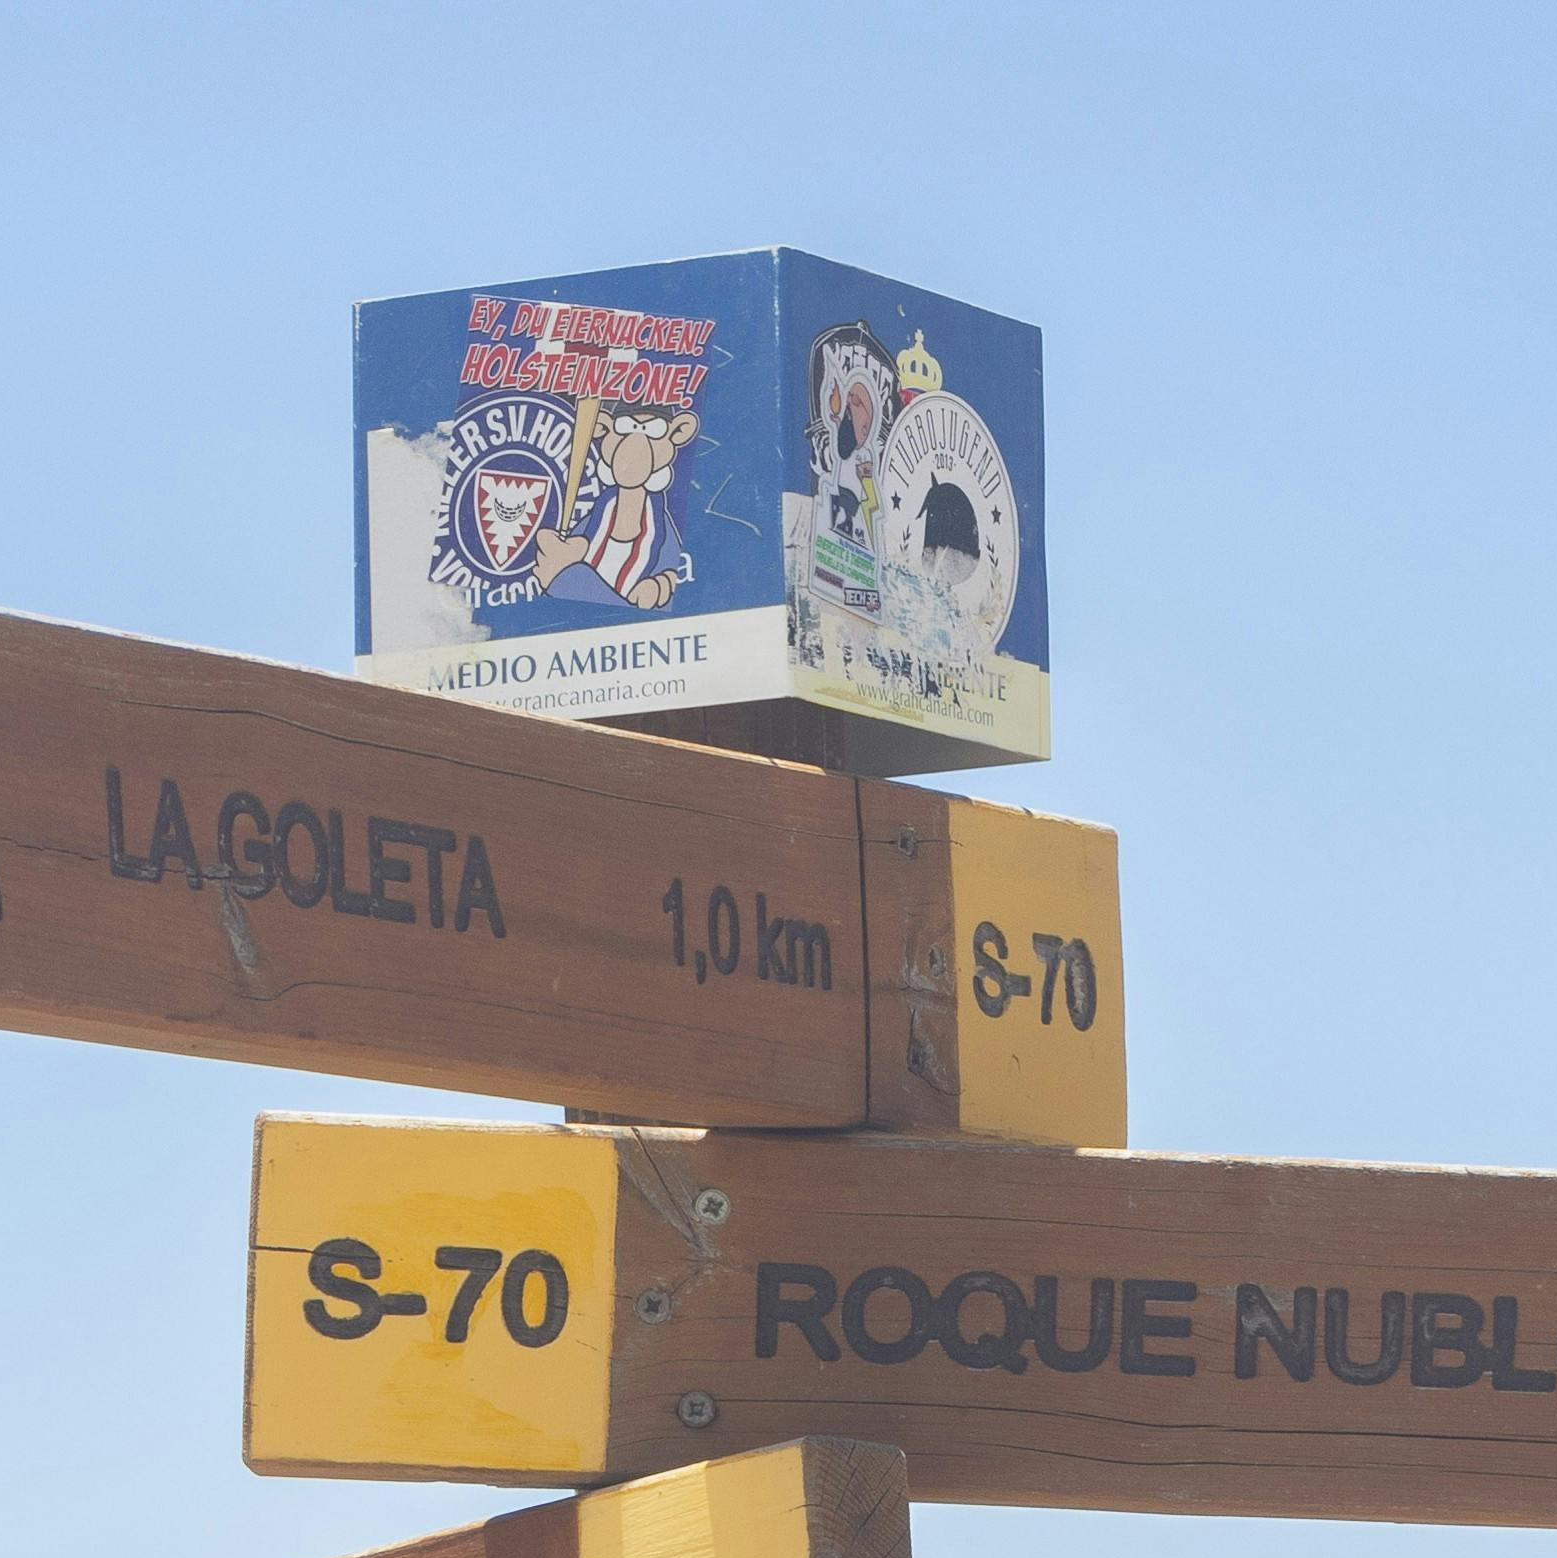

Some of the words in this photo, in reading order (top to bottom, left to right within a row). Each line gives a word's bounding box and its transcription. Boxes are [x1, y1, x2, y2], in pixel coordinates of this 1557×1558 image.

[460, 343, 708, 408] HOLSTEINZONE!
[468, 298, 506, 340] EY,
[510, 302, 549, 339] DU
[550, 306, 715, 357] EIERNACKEN!
[428, 655, 537, 692] MEDIO
[547, 634, 708, 680] AMBIENTE
[857, 682, 994, 727] www.grancanaria.com
[105, 766, 203, 891] LA
[218, 790, 507, 940] GOLETA
[661, 876, 741, 985] 1,0
[756, 892, 833, 991] km
[972, 920, 1098, 1032] S-70
[302, 1237, 570, 1349] S-70
[754, 1260, 1197, 1377] ROQUE
